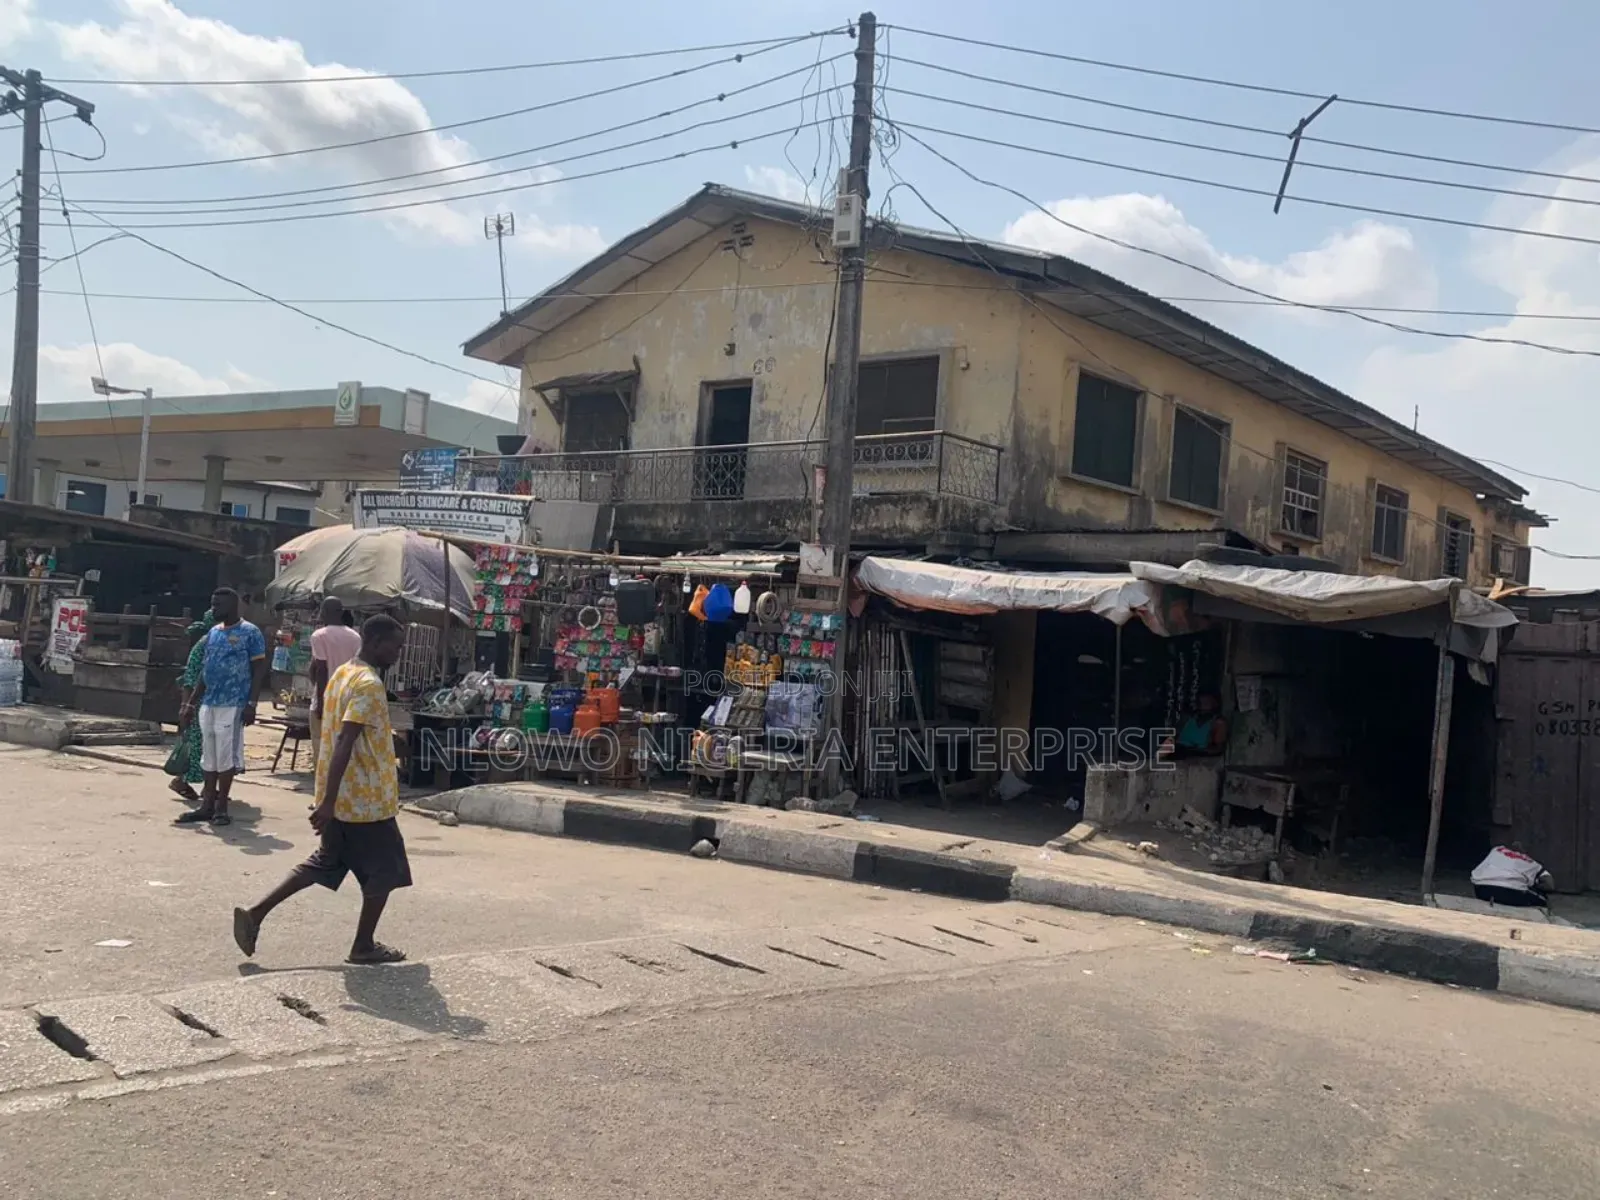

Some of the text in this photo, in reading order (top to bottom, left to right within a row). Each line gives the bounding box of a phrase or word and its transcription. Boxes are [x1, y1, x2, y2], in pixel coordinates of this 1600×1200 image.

[417, 496, 460, 510] SKINCARE
[461, 501, 468, 510] &
[469, 500, 523, 515] COSMETICS
